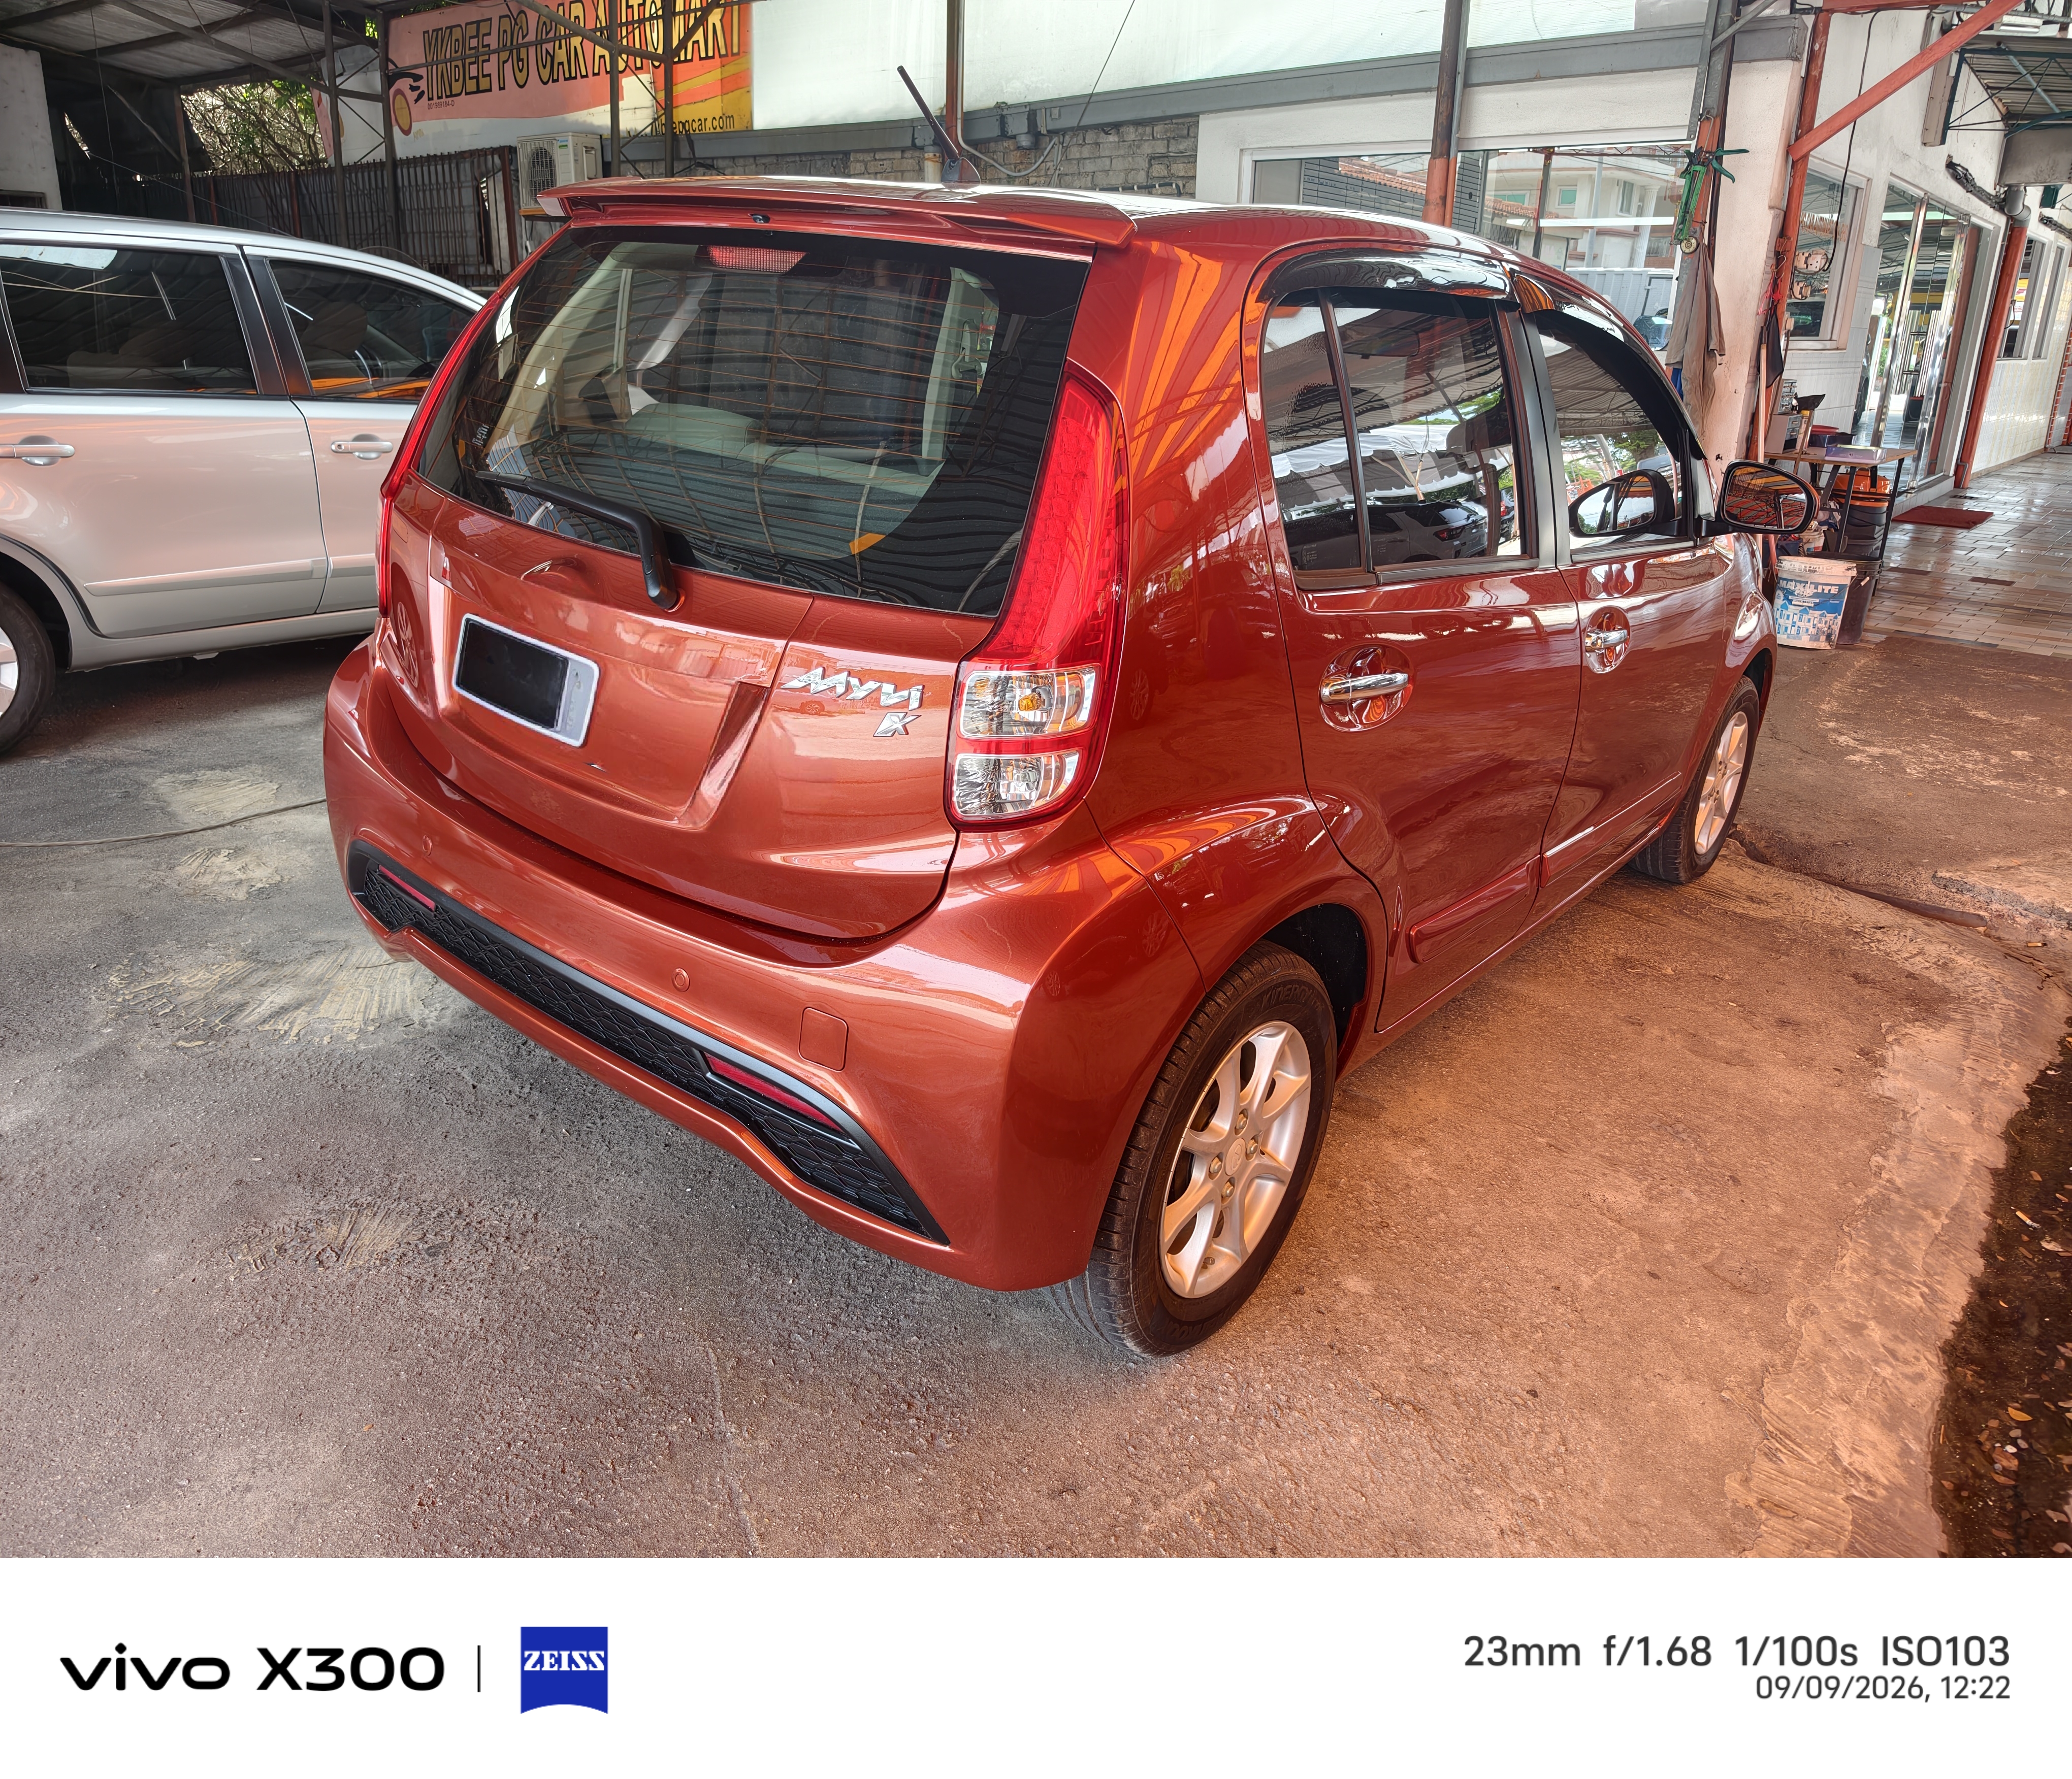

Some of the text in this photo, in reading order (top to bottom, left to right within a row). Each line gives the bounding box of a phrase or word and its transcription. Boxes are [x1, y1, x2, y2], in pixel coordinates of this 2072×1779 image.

[423, 17, 492, 101] YKBEE
[498, 10, 529, 91] PG
[536, 1, 589, 85] CAR
